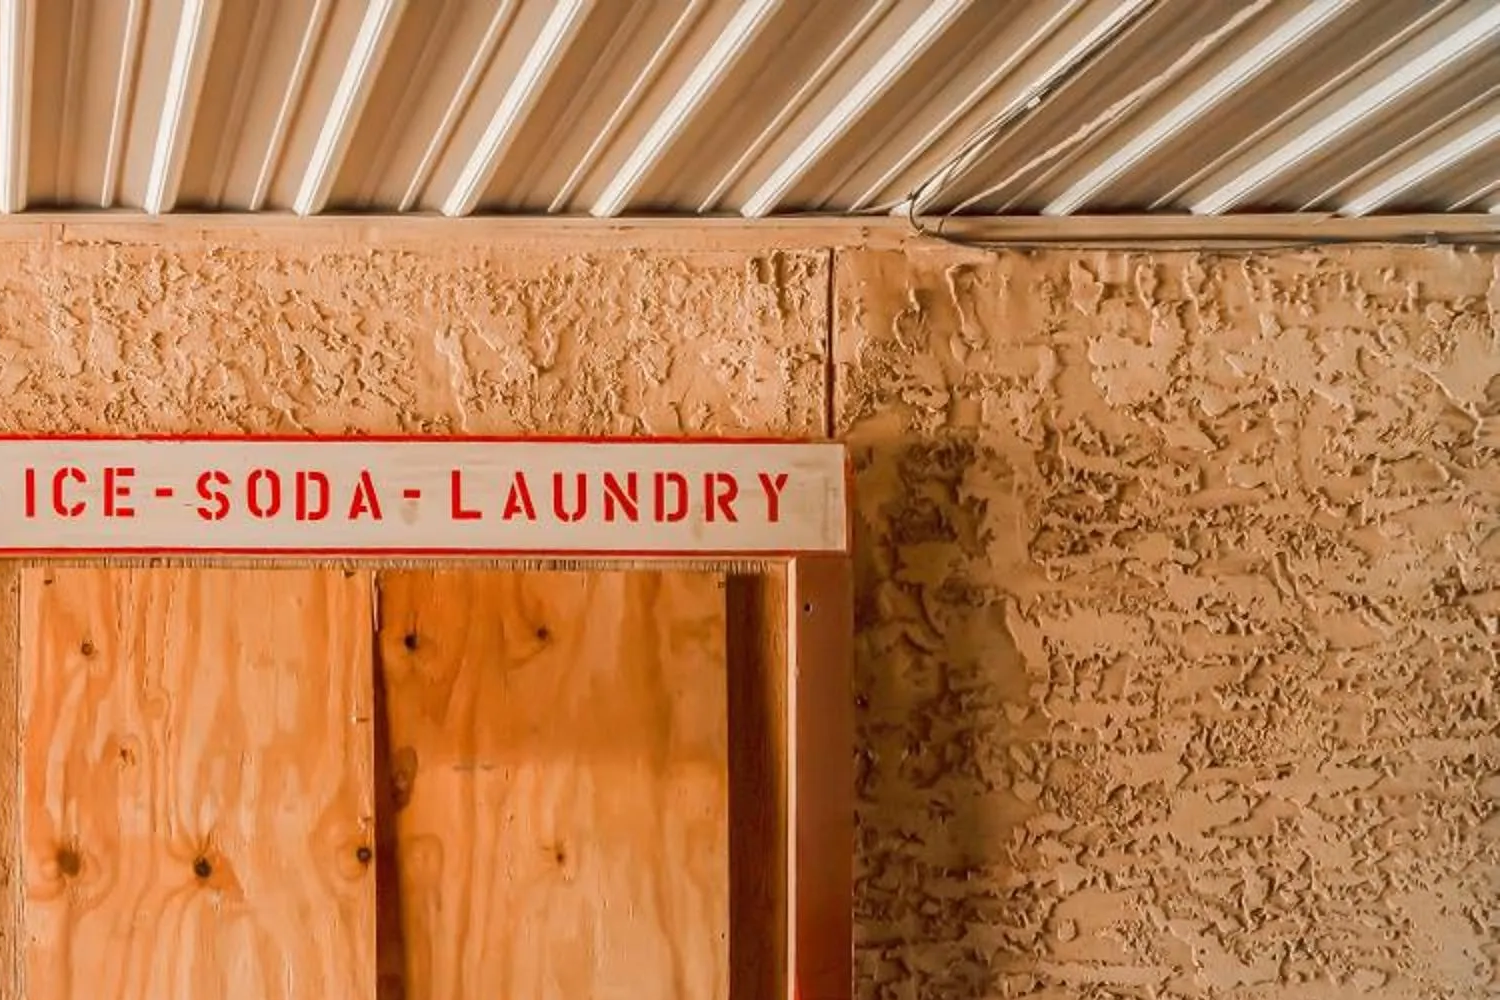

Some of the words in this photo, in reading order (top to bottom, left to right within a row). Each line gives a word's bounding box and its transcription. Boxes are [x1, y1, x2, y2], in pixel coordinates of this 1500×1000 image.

[24, 466, 135, 519] ICE
[195, 468, 383, 521] SODA
[450, 468, 789, 523] LAUNDRY
